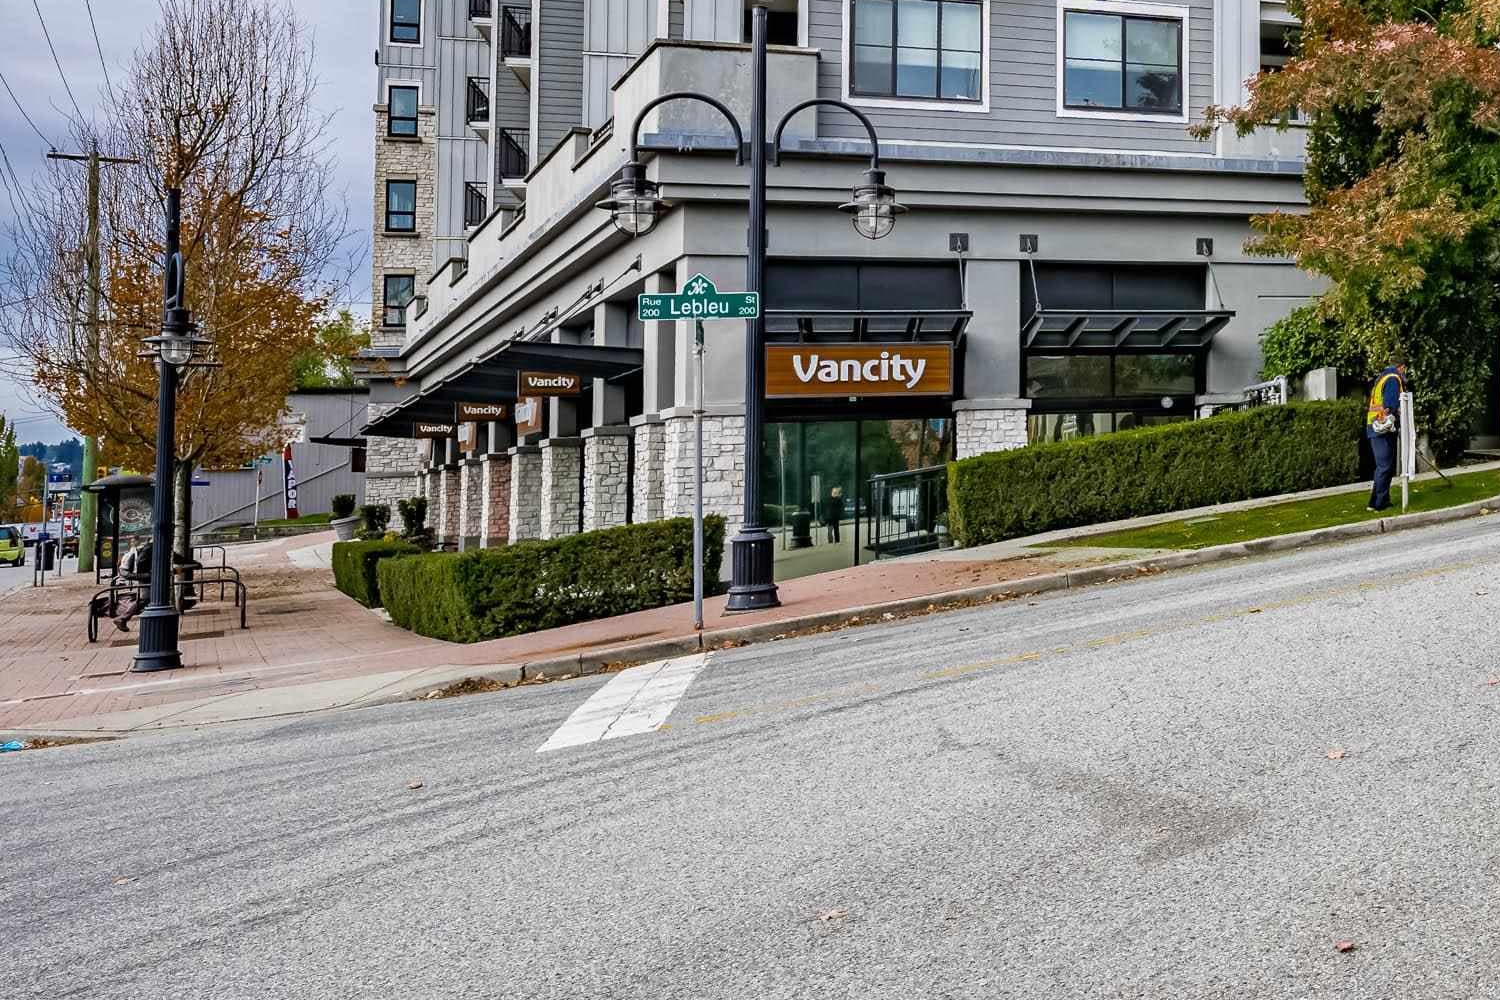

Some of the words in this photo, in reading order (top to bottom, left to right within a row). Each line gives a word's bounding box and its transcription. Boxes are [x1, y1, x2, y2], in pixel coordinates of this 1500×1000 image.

[642, 297, 662, 306] Rue
[670, 298, 729, 315] Lebleu
[745, 295, 755, 304] St
[738, 306, 756, 315] 200
[642, 308, 660, 317] 200
[792, 351, 926, 389] Vancity
[527, 375, 575, 389] Vancity
[463, 405, 502, 416] Vancity
[420, 424, 453, 434] Vancity
